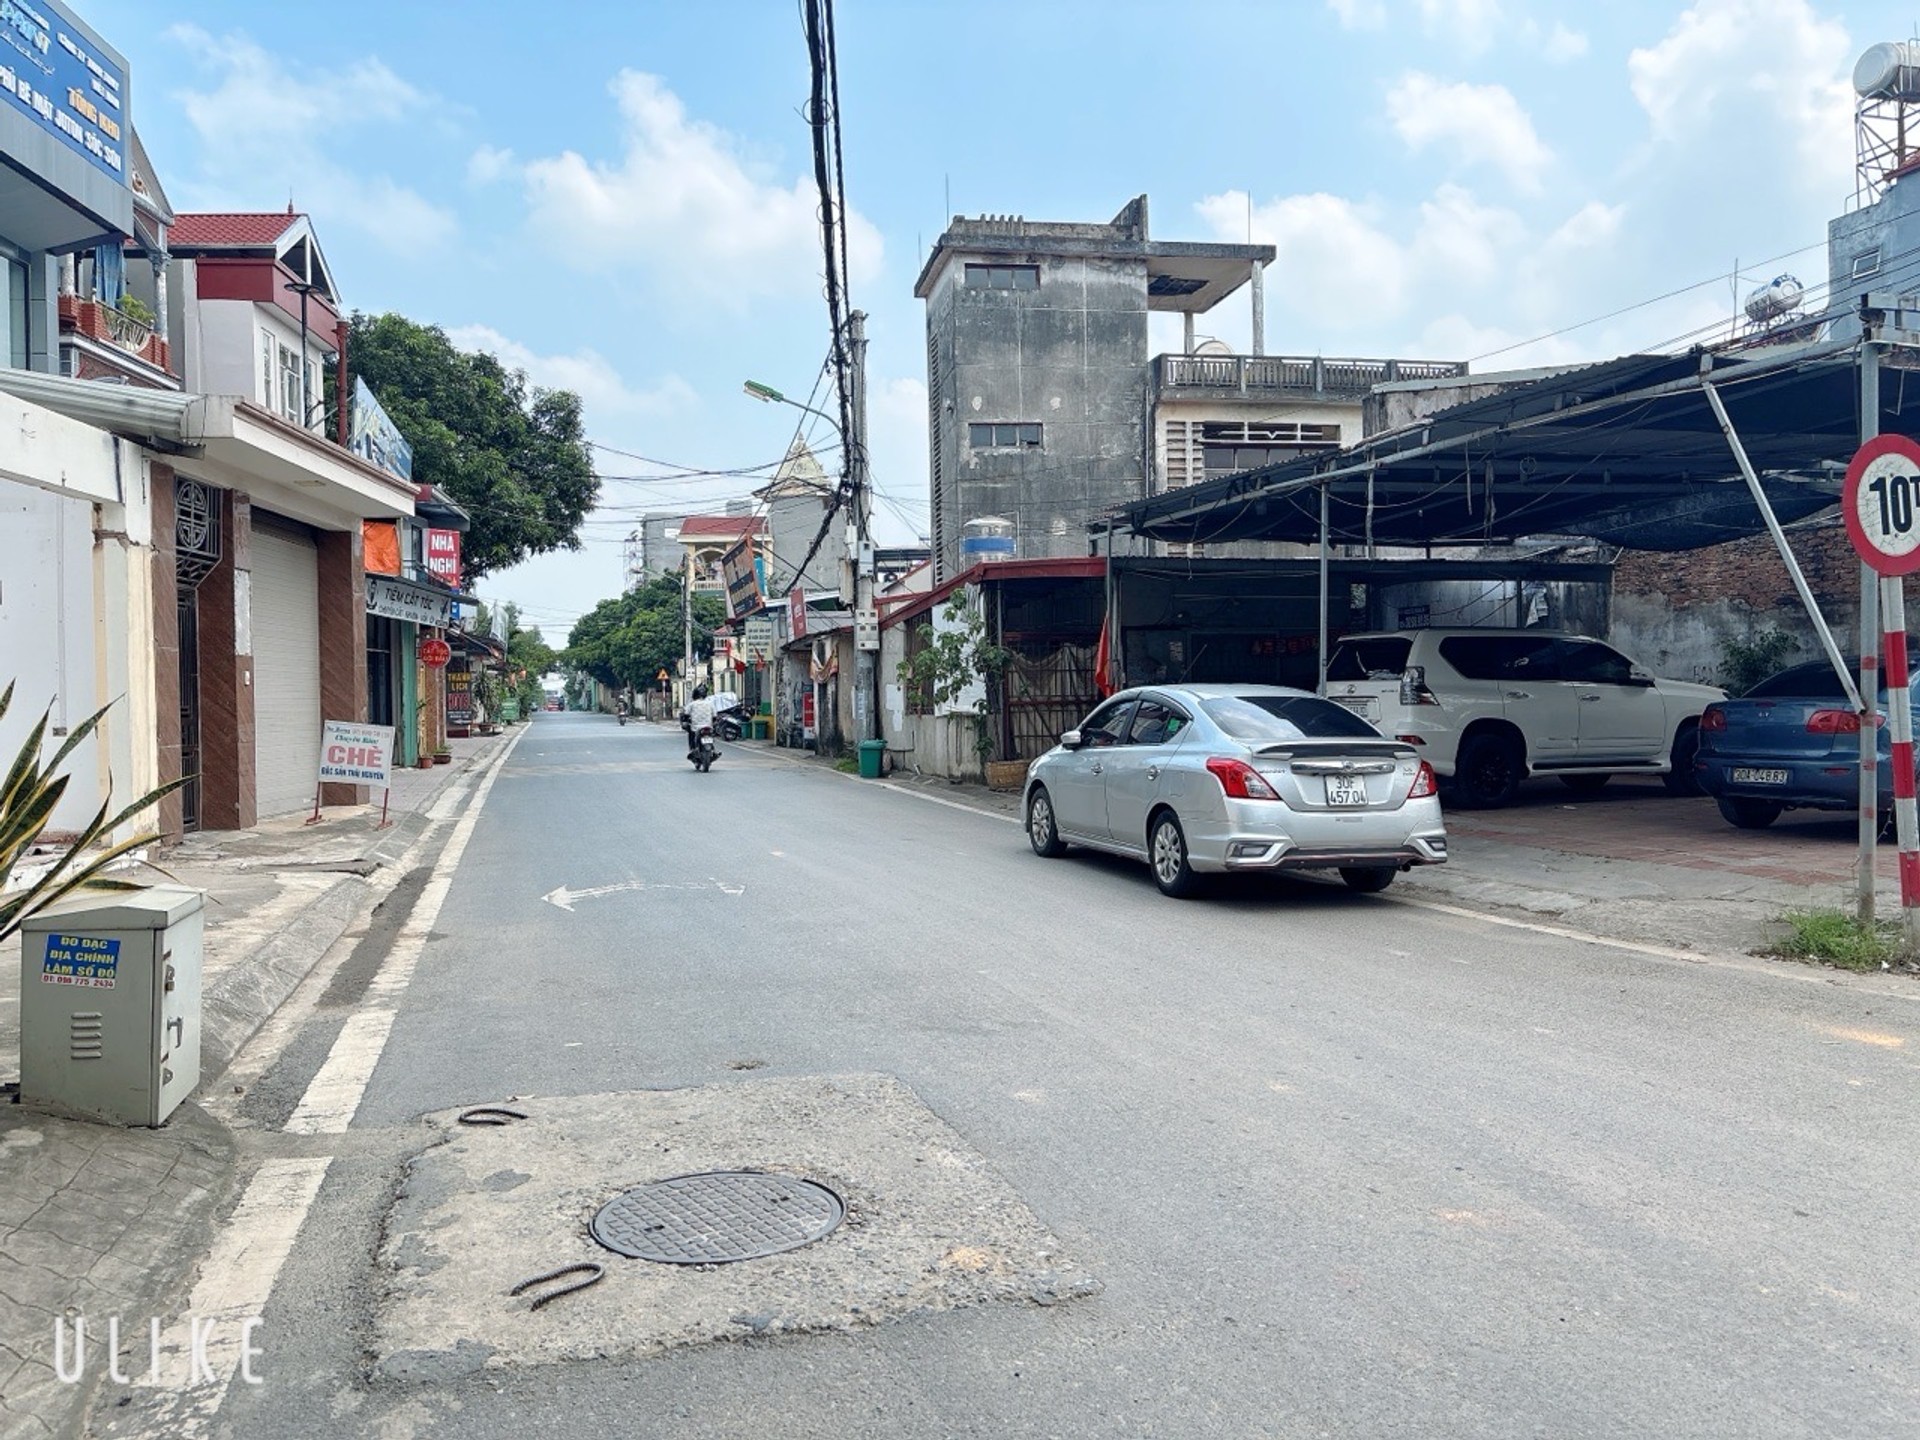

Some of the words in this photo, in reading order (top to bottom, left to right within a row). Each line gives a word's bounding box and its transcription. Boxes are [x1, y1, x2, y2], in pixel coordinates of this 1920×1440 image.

[327, 745, 383, 768] CHÈ
[1330, 790, 1366, 804] 457.04
[75, 951, 115, 964] CHÍNH
